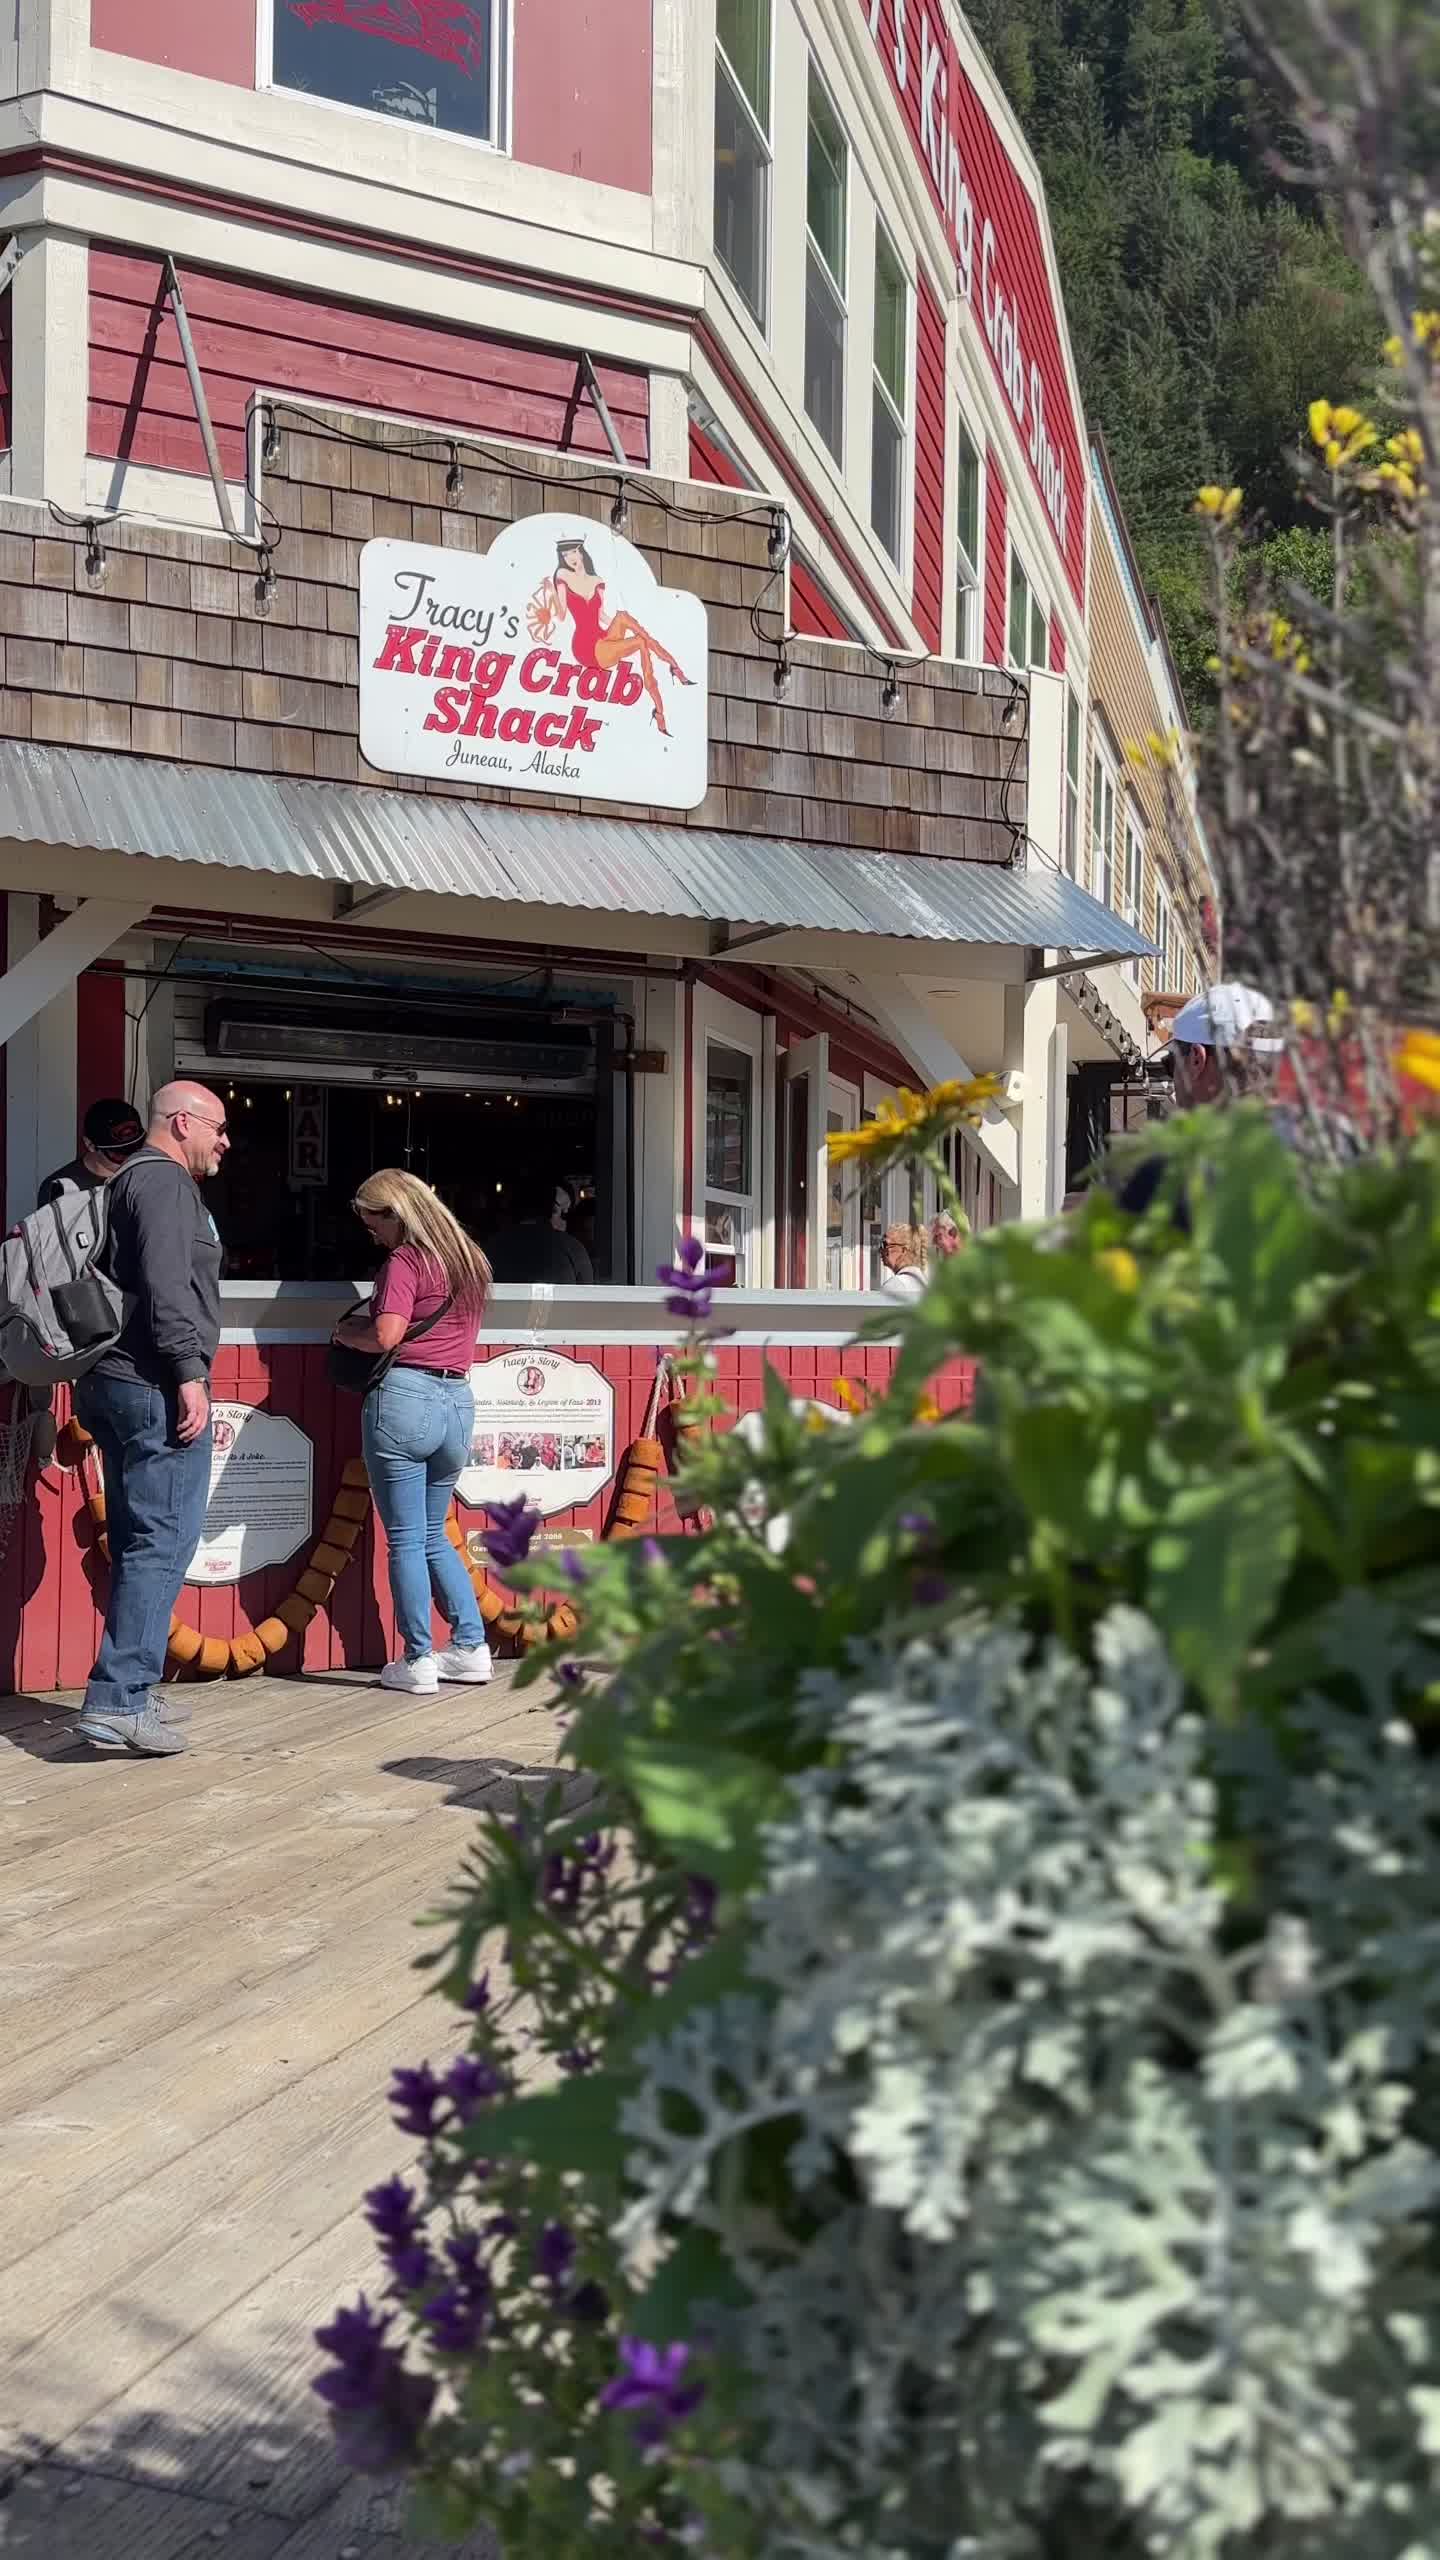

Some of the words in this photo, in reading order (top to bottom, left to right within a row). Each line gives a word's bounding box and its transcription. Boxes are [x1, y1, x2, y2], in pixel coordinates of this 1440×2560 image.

[920, 8, 974, 305] King
[981, 217, 1024, 426] Crab
[1030, 358, 1067, 558] Shack
[387, 570, 520, 647] Tracy's
[372, 624, 515, 698] King
[519, 646, 645, 707] Crab
[422, 686, 603, 753] Shack
[445, 739, 513, 773] Juneau,
[519, 750, 581, 780] Alaska
[502, 1355, 536, 1369] Tracy's
[537, 1356, 561, 1369] Story
[227, 1409, 254, 1423] Story
